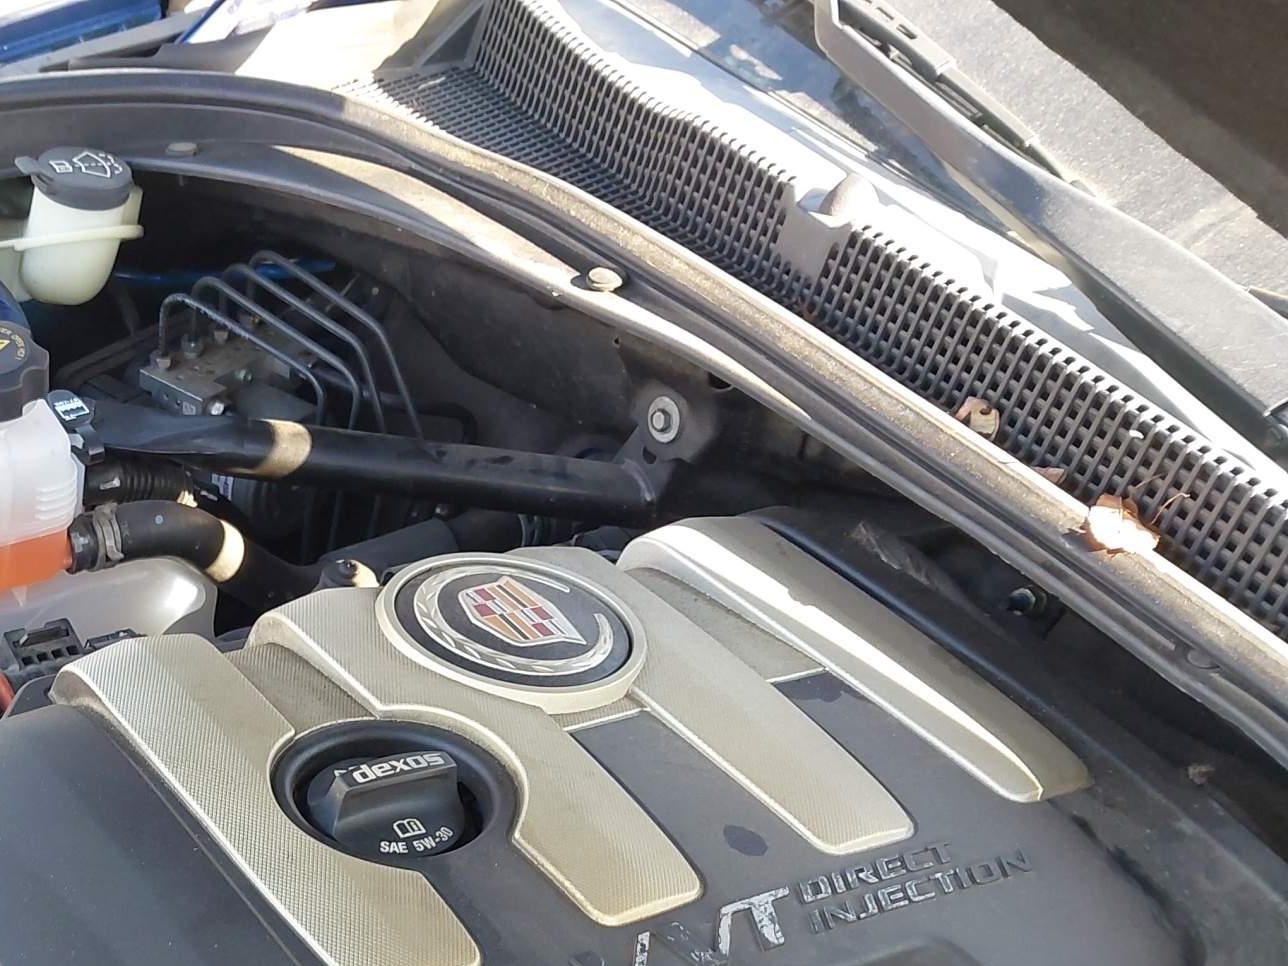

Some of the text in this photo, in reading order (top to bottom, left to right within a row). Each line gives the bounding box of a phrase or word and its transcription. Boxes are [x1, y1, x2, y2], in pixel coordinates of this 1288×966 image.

[352, 753, 447, 784] dexos
[380, 826, 454, 854] SAE 5W-30
[799, 842, 953, 905] DIRECT
[808, 848, 1033, 935] INJECTION
